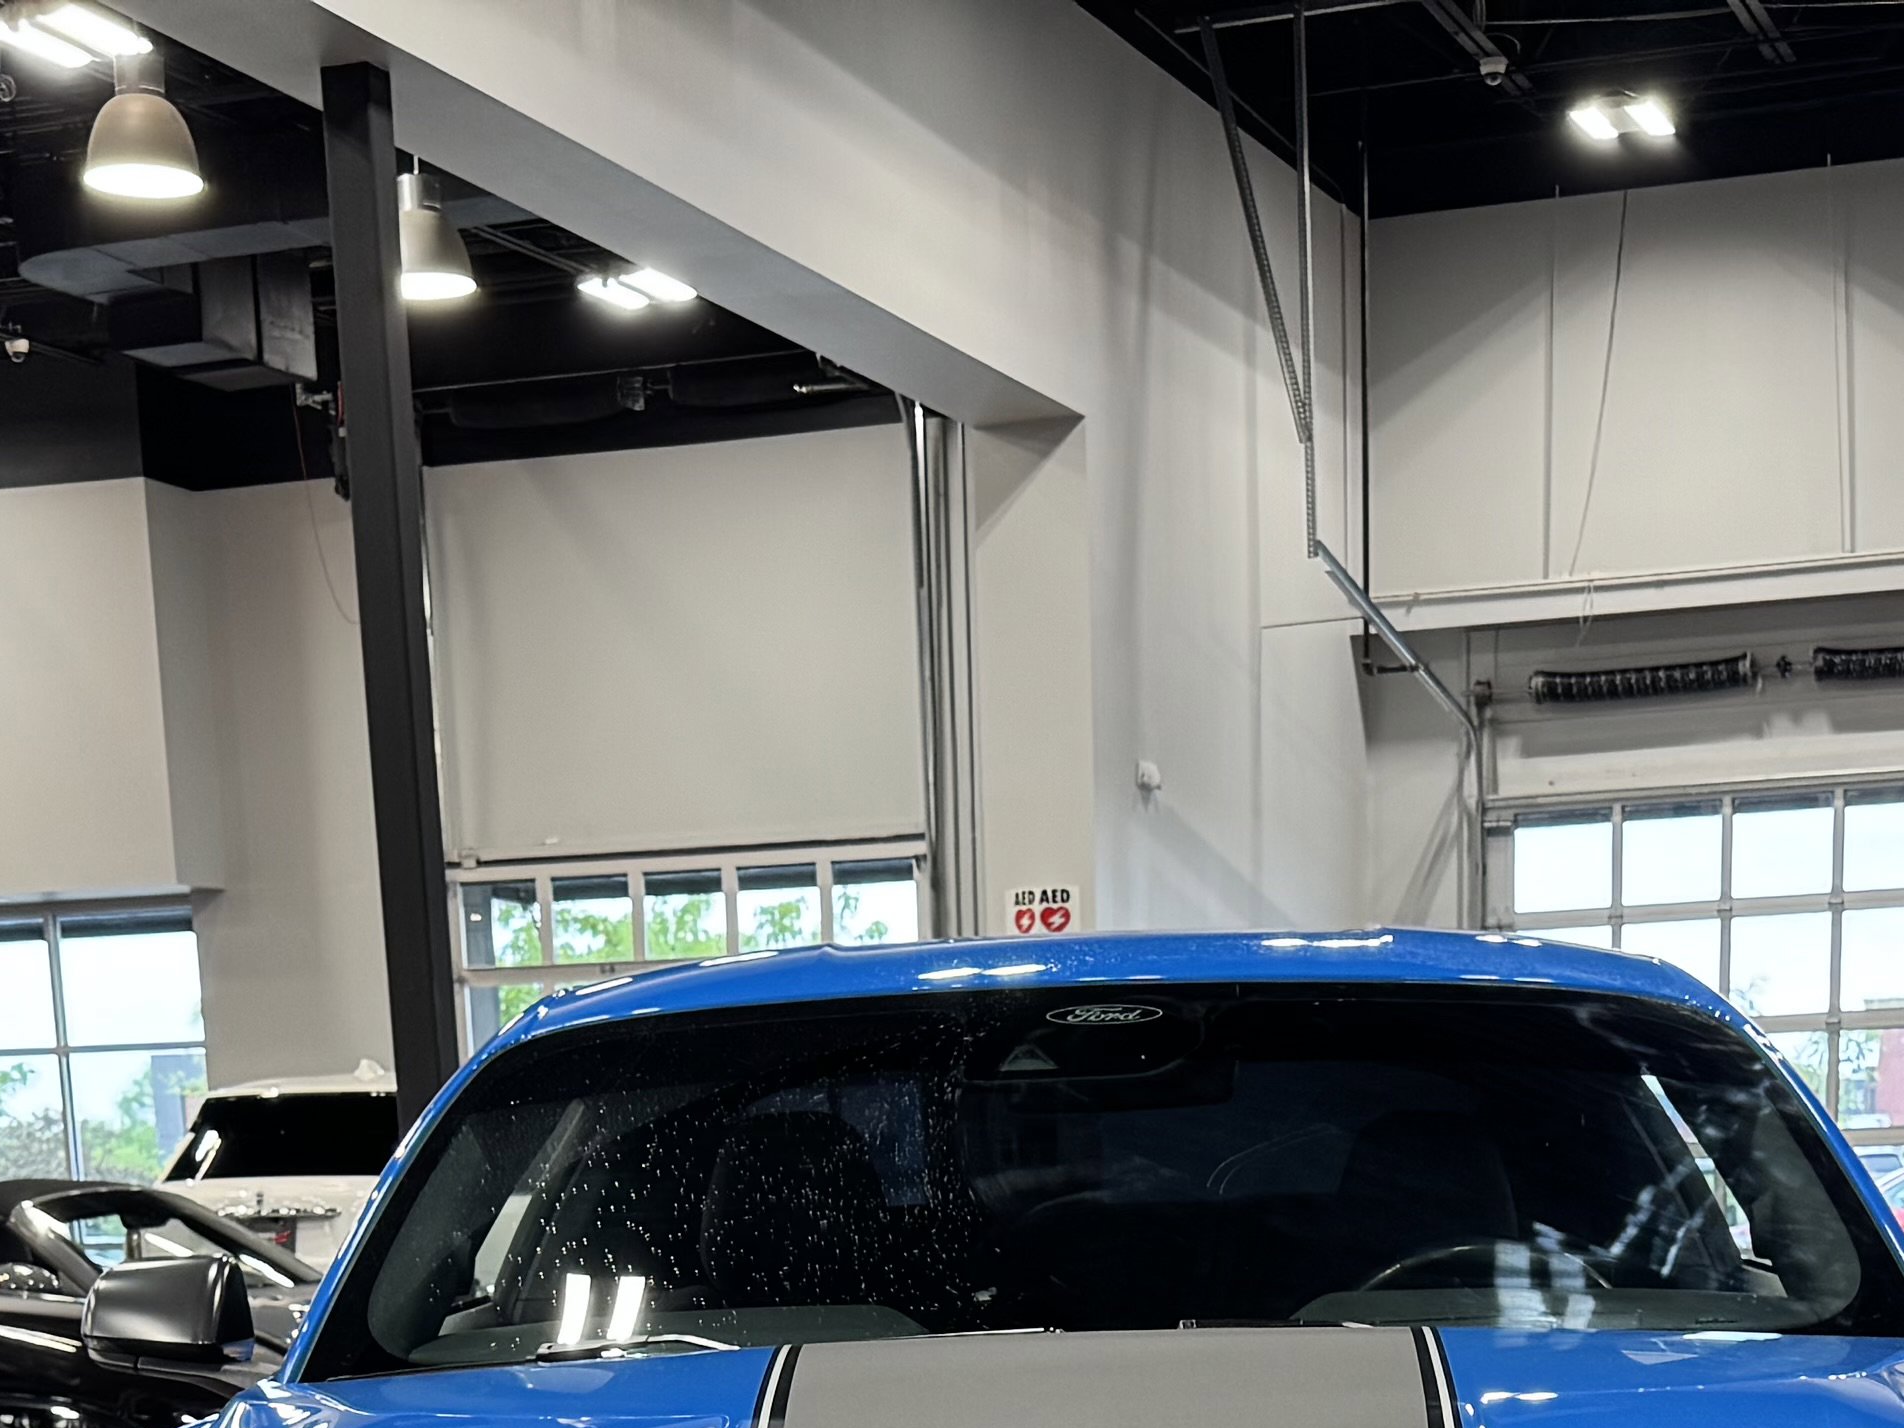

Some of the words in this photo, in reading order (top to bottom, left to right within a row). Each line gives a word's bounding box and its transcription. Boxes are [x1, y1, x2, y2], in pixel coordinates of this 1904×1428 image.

[1014, 890, 1036, 906] AED
[1039, 889, 1070, 905] AED
[1067, 1007, 1142, 1022] Ford
